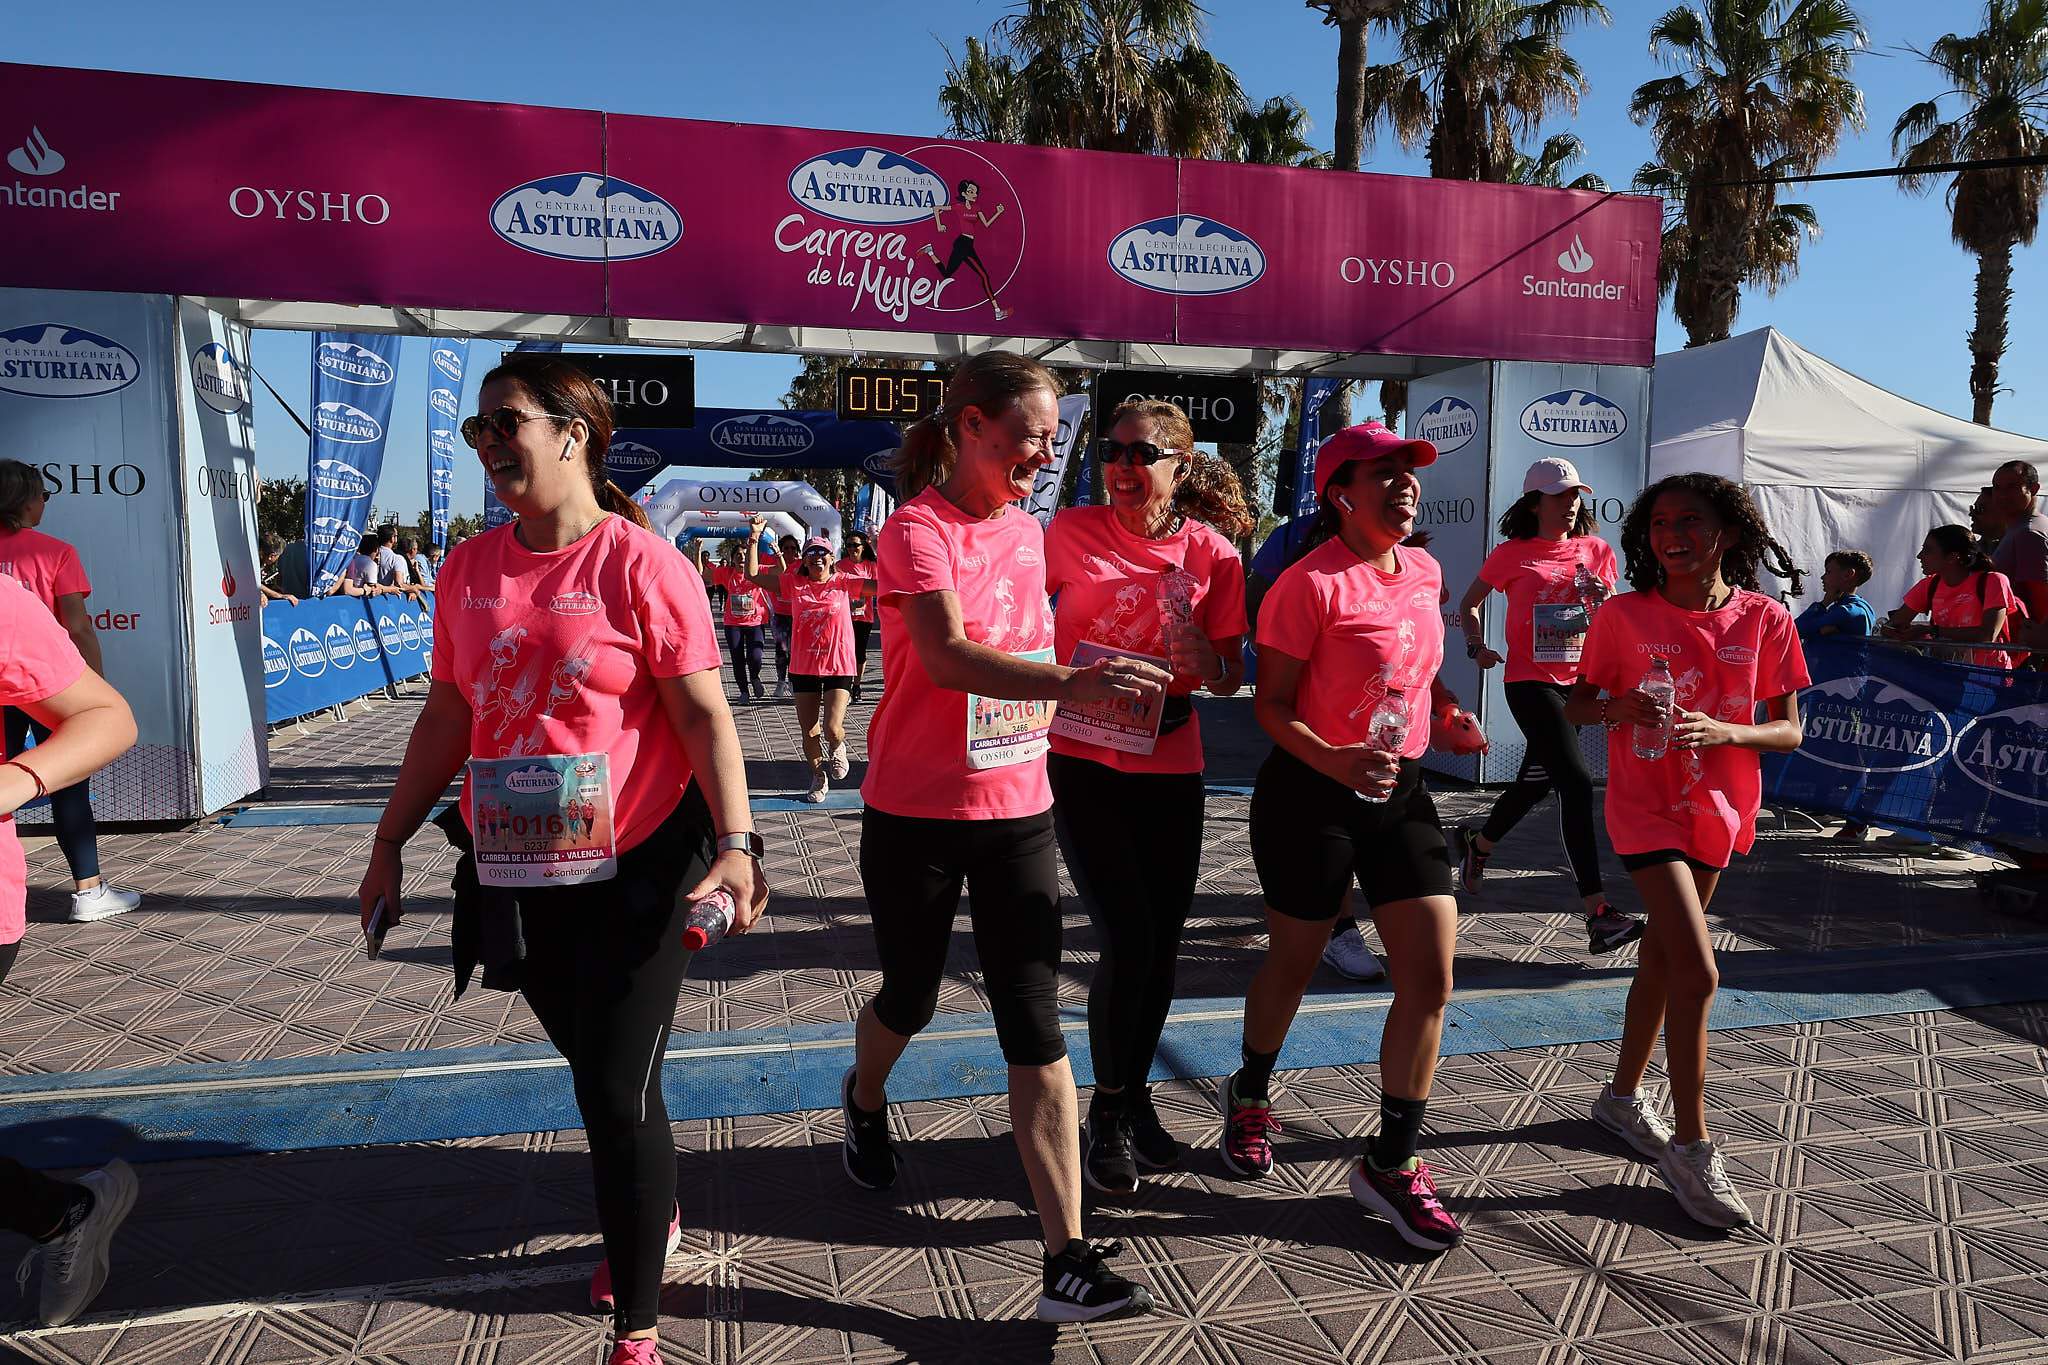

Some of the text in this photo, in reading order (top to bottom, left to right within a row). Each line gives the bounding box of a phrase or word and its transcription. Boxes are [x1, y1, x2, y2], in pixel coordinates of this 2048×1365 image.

[826, 170, 932, 186] CENTRAL LECHERA
[0, 181, 120, 210] ntander
[801, 171, 936, 208] ASTURIANA
[229, 186, 390, 225] OYSHO
[535, 200, 664, 216] CENTRAL ECHERA
[505, 201, 669, 241] ASTURIANA
[774, 214, 906, 260] Carrera
[1145, 240, 1250, 254] CENTRAL LECHERA
[1120, 240, 1253, 277] ASTURIANA
[1340, 256, 1456, 288] OYSHO
[807, 257, 955, 322] de la Mujer
[1522, 274, 1625, 300] Santander
[5, 348, 122, 360] CENTRAL LECHERA
[1419, 420, 1472, 441] ASTURIANA
[1528, 409, 1619, 434] ASTURIANA
[719, 426, 807, 447] ASTURIANA
[198, 465, 250, 501] OYSHO
[699, 486, 780, 504] OYSHO
[1415, 497, 1475, 525] OYSHO
[208, 602, 250, 626] Santander
[1351, 599, 1391, 613] OYSHO
[1637, 643, 1681, 654] OYSHO
[1003, 700, 1034, 721] 016
[1818, 702, 1934, 727] CENTRAL LECHERA
[1060, 709, 1083, 723] CARRERA
[1083, 716, 1091, 724] DE
[1092, 718, 1099, 726] LA
[1100, 720, 1120, 731] MUJER
[1125, 726, 1151, 737] VALENCIA
[1062, 722, 1093, 737] OYSHO
[975, 739, 1001, 749] CARRERA
[1002, 737, 1010, 745] DE
[1010, 736, 1017, 744] LA
[981, 749, 1013, 762] OYSHO
[508, 777, 560, 788] ASTURIANA
[512, 814, 564, 836] 016
[481, 853, 510, 862] CARRERA
[511, 853, 521, 862] DE
[522, 853, 531, 861] LA
[533, 852, 560, 861] MUJER
[566, 849, 604, 860] VALENCIA
[524, 841, 548, 850] 6237
[489, 866, 600, 879] OYSHO Santander
